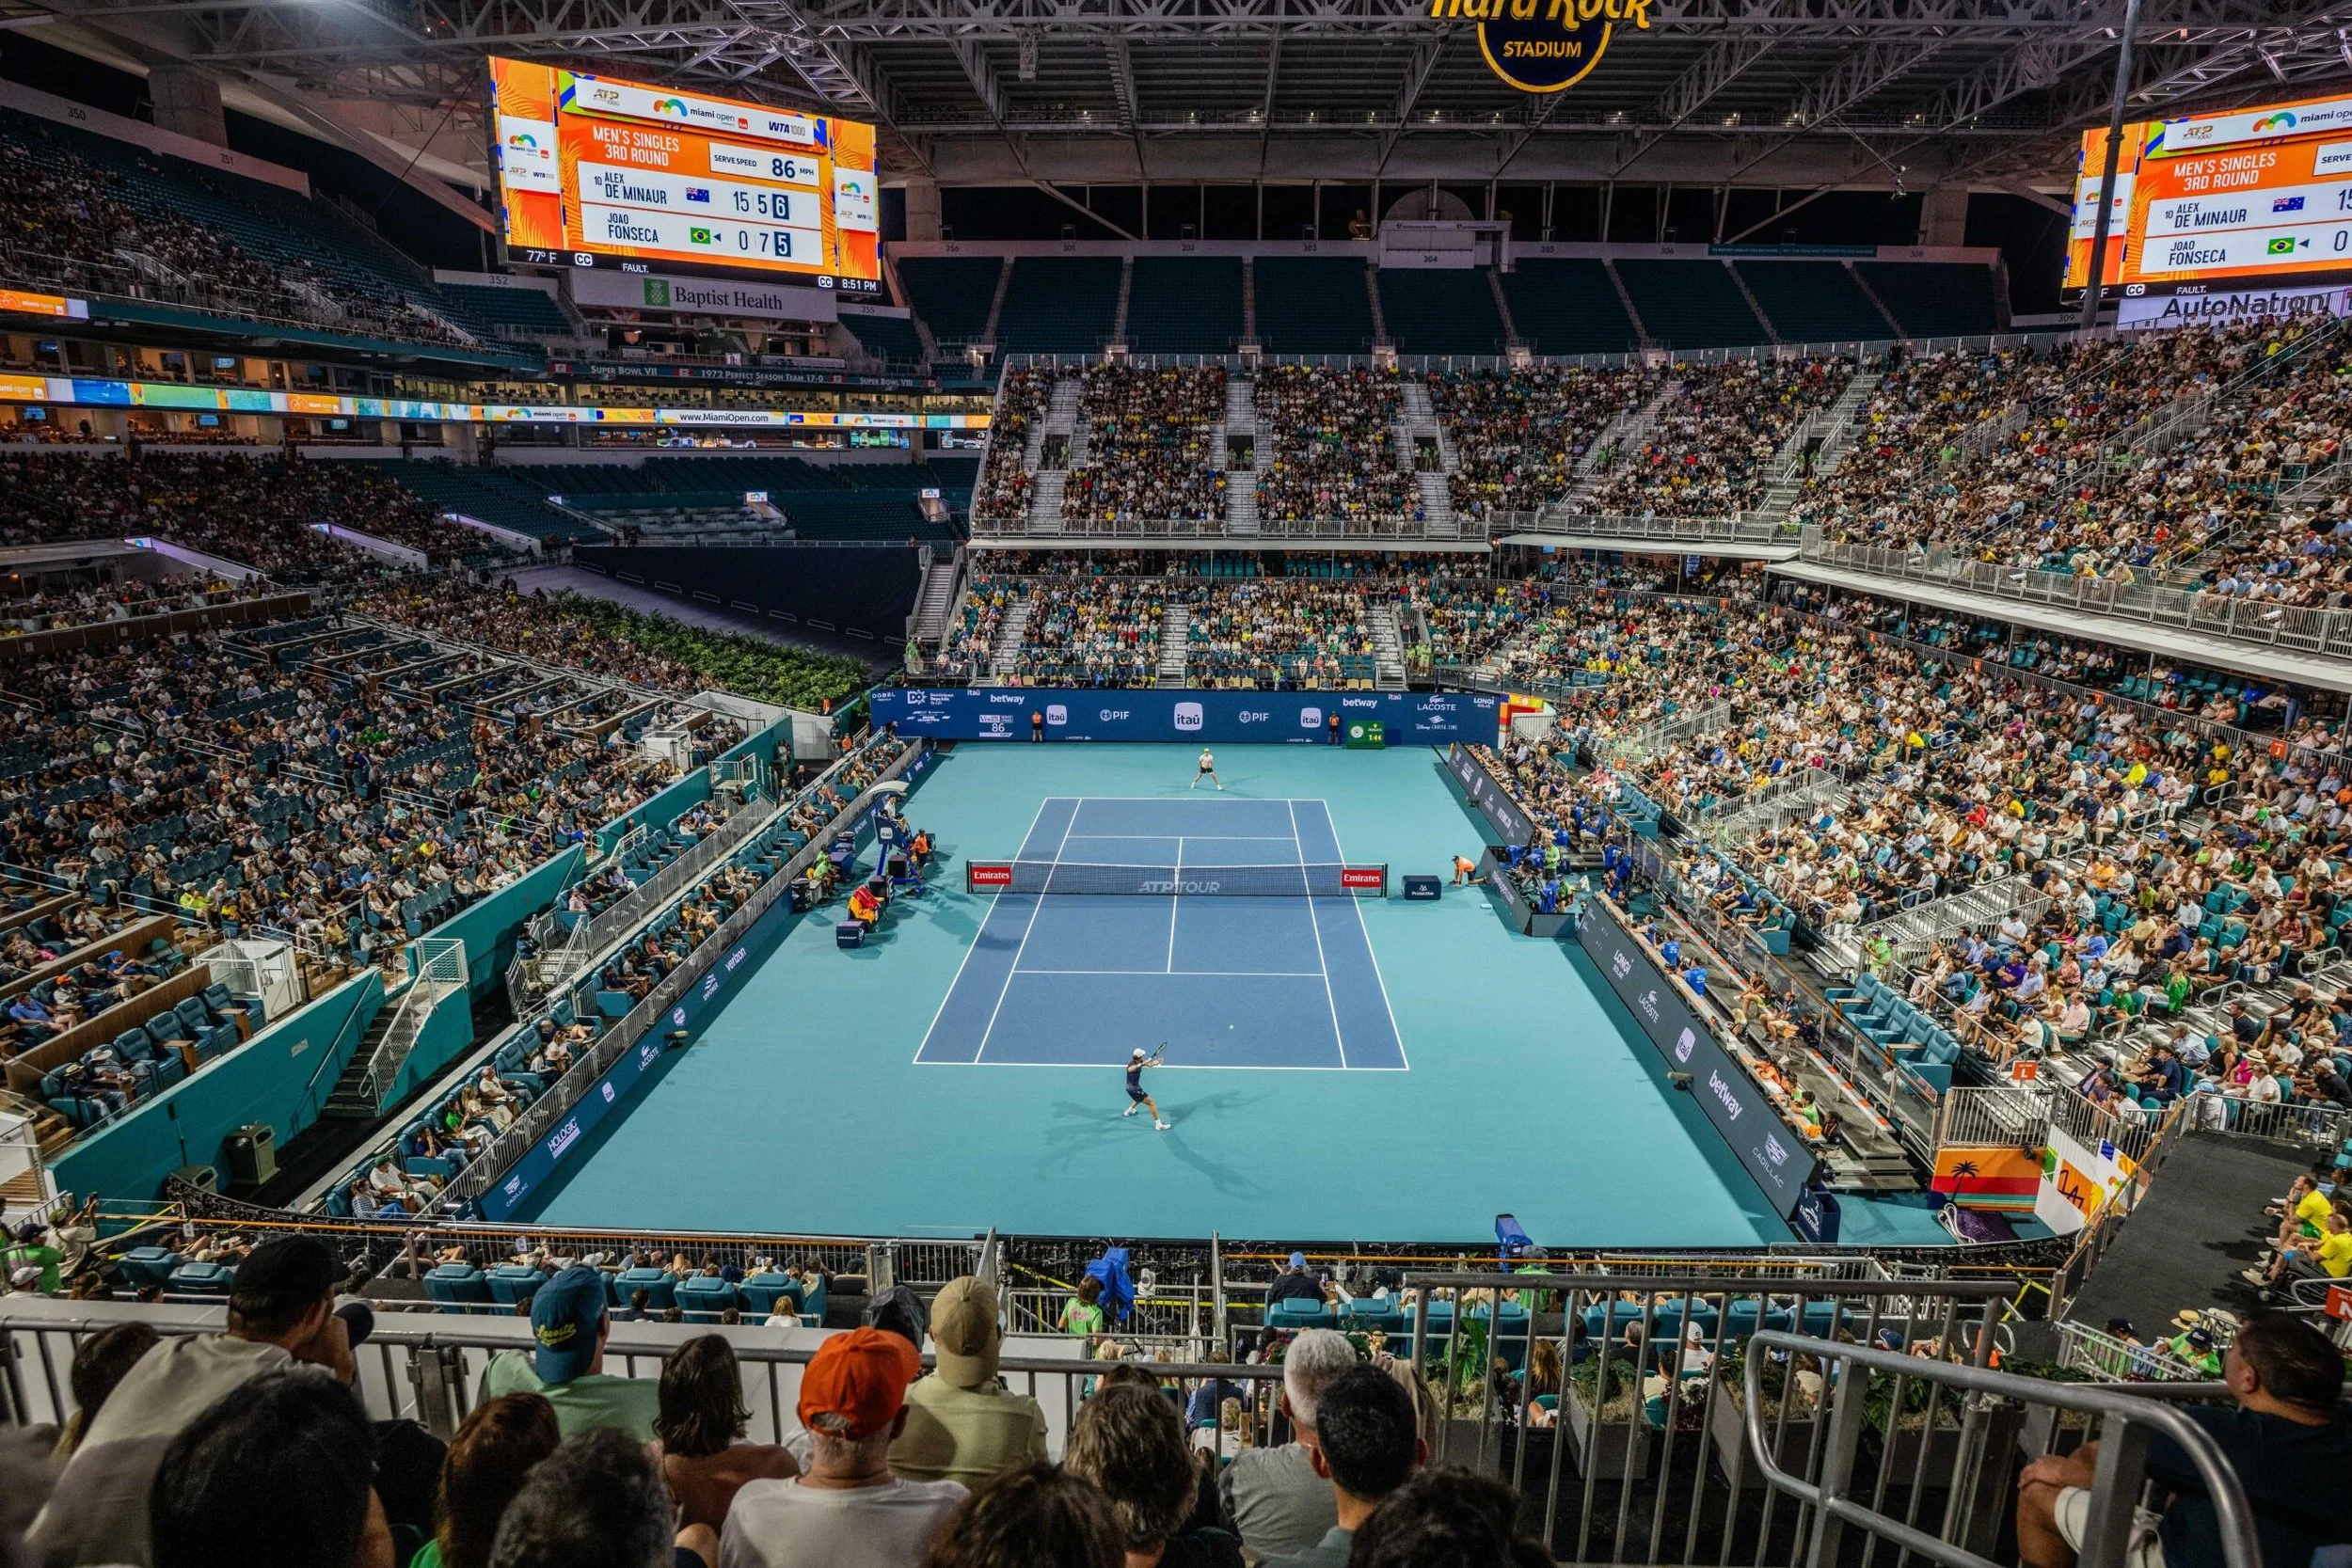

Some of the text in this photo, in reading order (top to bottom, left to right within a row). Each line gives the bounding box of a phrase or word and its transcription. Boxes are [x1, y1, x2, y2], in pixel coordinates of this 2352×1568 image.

[1502, 41, 1582, 57] STADIUM
[594, 88, 618, 100] ATP
[67, 106, 86, 121] 350
[691, 108, 735, 122] miami open
[2300, 111, 2334, 123] miami
[769, 121, 789, 134] WTA
[2184, 126, 2213, 137] ATP
[593, 126, 679, 152] MEN'S SINGLES
[220, 152, 234, 166] 351
[605, 145, 669, 166] 3RD ROUND
[714, 154, 757, 167] SERVE SPEED
[2321, 154, 2352, 164] SERVE
[771, 158, 796, 178] 86
[2174, 153, 2276, 177] MEN'S SINGLES
[800, 167, 815, 176] MPH
[594, 176, 602, 186] 10
[605, 172, 625, 184] ALEX
[2183, 170, 2259, 190] 3RD ROUND
[605, 183, 667, 204] DE MINAUR
[733, 191, 749, 213] 15
[757, 194, 768, 214] 5
[775, 197, 786, 216] 6
[2177, 202, 2200, 214] ALEX
[608, 213, 628, 224] JOAO
[2165, 210, 2173, 220] 10
[2174, 209, 2247, 228] DE MINAUR
[609, 224, 659, 243] FONSECA
[739, 230, 748, 250] 0
[759, 232, 769, 252] 7
[778, 234, 787, 254] 5
[2170, 241, 2195, 251] JOAO
[2334, 230, 2348, 251] 0
[1540, 245, 1554, 254] 305
[1910, 250, 1924, 259] 308
[549, 252, 557, 263] F
[576, 255, 592, 264] CC
[1423, 255, 1438, 263] 304
[2169, 249, 2226, 266] FONSECA
[622, 262, 649, 274] FAULT.
[489, 276, 508, 284] 352
[865, 281, 877, 291] PM
[2127, 286, 2144, 295] CC
[2177, 285, 2207, 294] FAULT.
[675, 286, 783, 310] Baptist Health
[2162, 291, 2330, 319] AutoNation
[2058, 314, 2075, 323] 309
[644, 368, 658, 376] VII
[702, 370, 723, 378] 1972
[807, 374, 824, 383] 17-0
[901, 378, 914, 387] VIII
[679, 412, 769, 424] www.MiamiOpen.com
[990, 694, 1025, 705] betway
[1343, 698, 1377, 708] betway
[1113, 711, 1130, 720] PIF
[1177, 714, 1200, 725] itaú
[1252, 712, 1269, 721] PIF
[992, 723, 1006, 732] 86
[974, 871, 1009, 879] Emirates
[1343, 873, 1380, 883] Emirates
[1138, 880, 1220, 893] ATP TOUR
[725, 947, 746, 972] verizon
[1638, 992, 1660, 1023] LACOSTE
[1677, 1037, 1690, 1057] itaú
[638, 1046, 660, 1071] LACOSTE
[2021, 1069, 2028, 1078] L
[1708, 1069, 1742, 1121] betway
[548, 1117, 579, 1152] HOLOGIC
[1752, 1147, 1785, 1188] CADILLAC
[506, 1183, 529, 1207] CADILLAC
[1804, 1188, 1808, 1197] 1
[1815, 1201, 1820, 1212] 2
